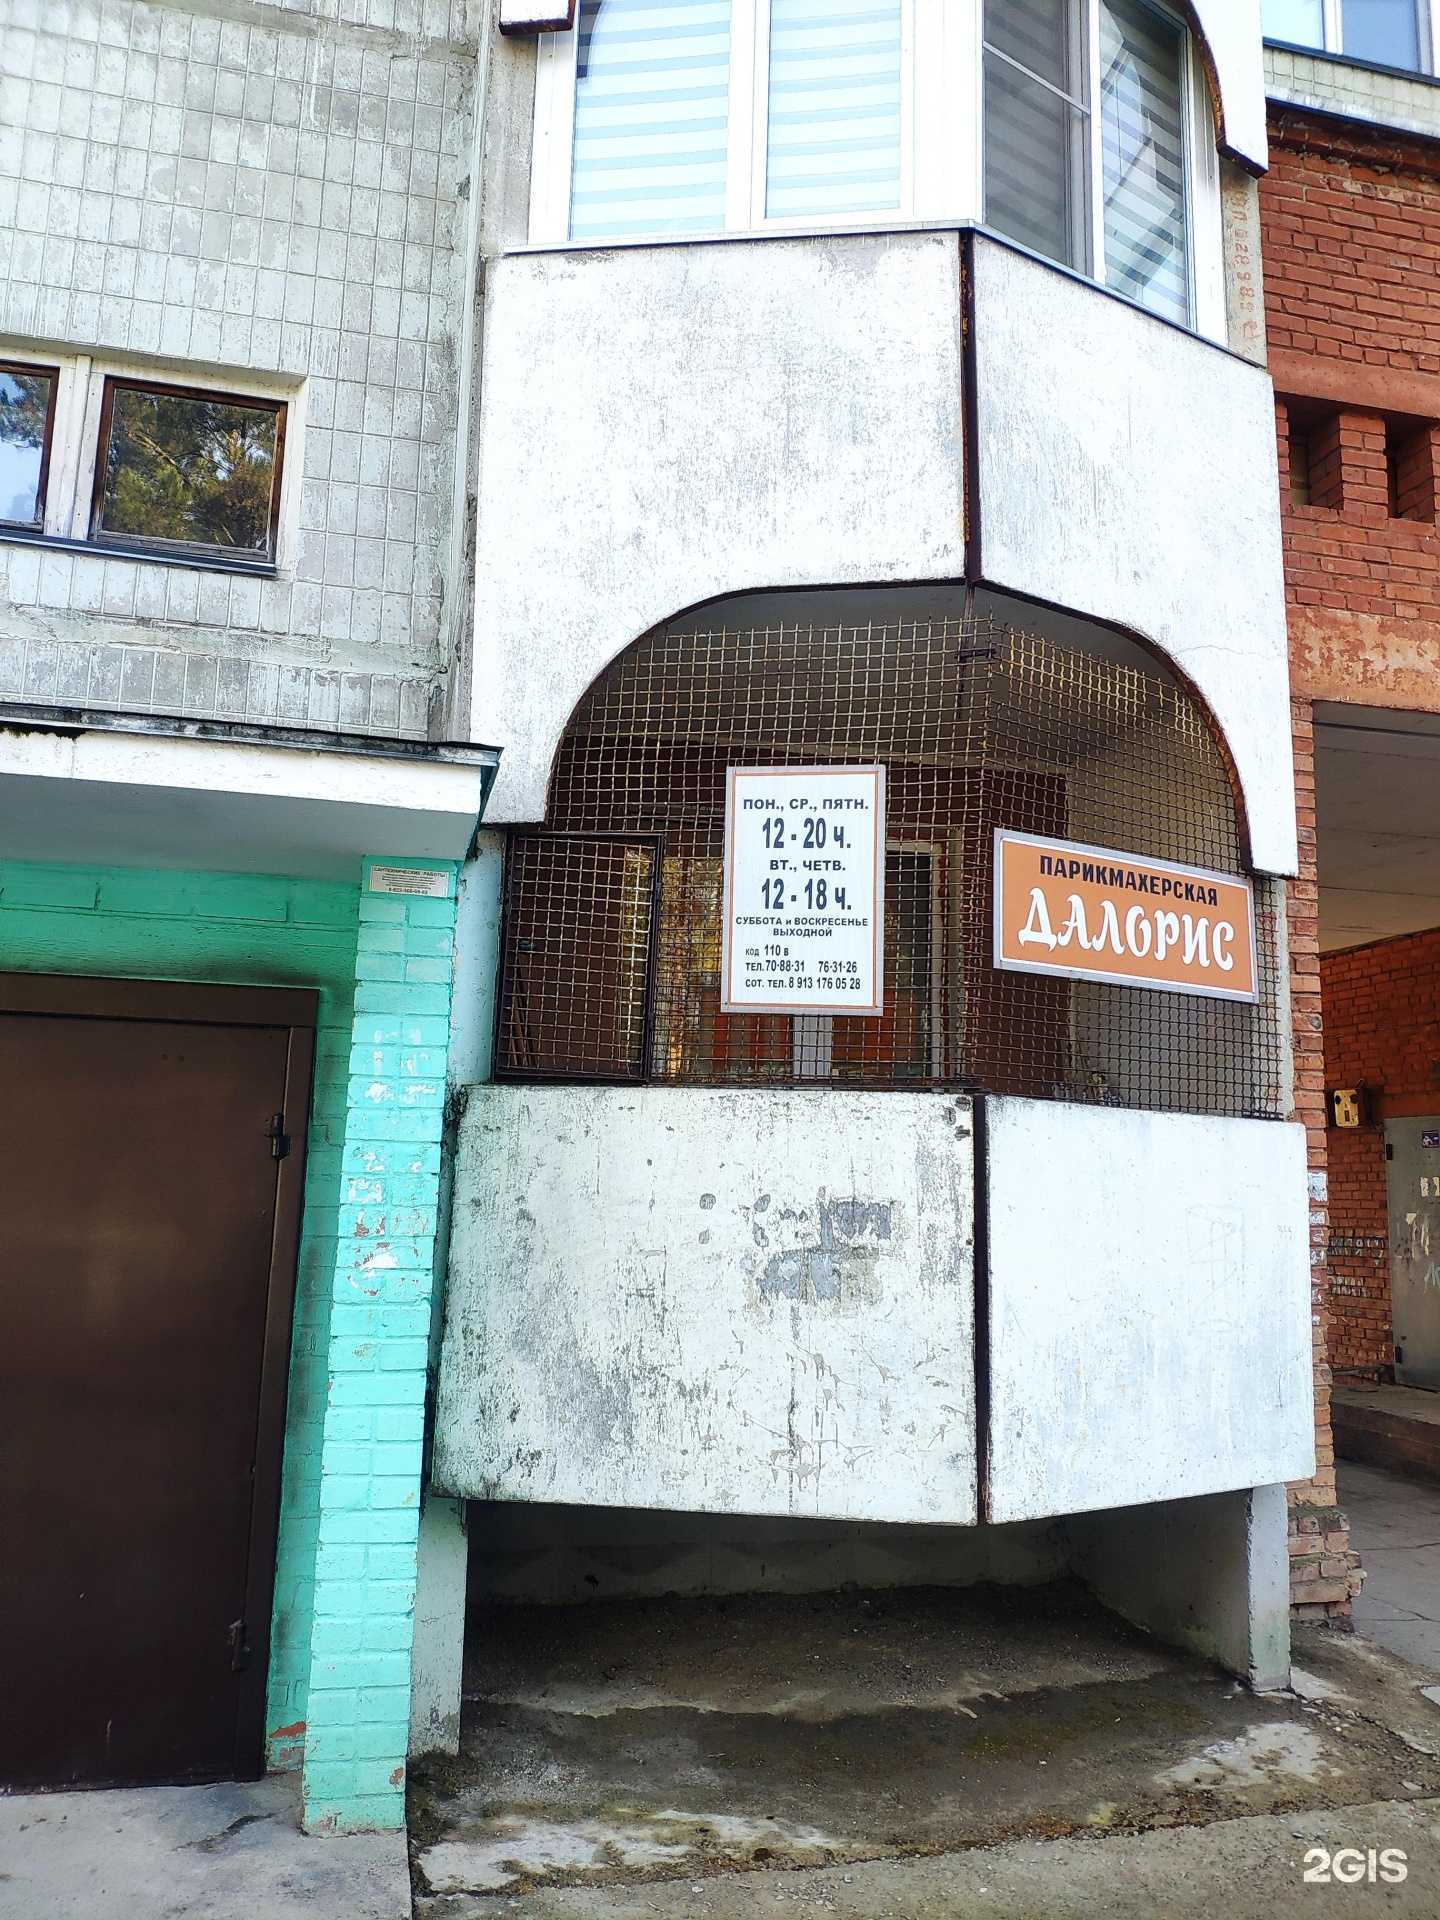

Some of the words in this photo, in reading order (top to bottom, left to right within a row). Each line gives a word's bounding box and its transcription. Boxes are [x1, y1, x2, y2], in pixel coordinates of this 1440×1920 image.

[743, 798, 784, 812] ПОН.,
[789, 798, 817, 812] СР.,
[822, 798, 869, 810] ПЯТН.
[762, 817, 785, 849] 12
[802, 817, 827, 849] 20
[769, 859, 797, 873] ВТ.,
[802, 859, 846, 871] ЧЕТВ.
[1040, 855, 1218, 906] ПАРИКМАХЕРСКАЯ
[761, 878, 785, 910] 12
[804, 878, 828, 911] 18
[735, 916, 783, 926] СУББОТА
[794, 917, 869, 927] ВОСКРЕСЕНЬЕ
[773, 927, 833, 939] ВЫХОДНОЙ
[1018, 887, 1234, 971] ДАЛОРИС
[764, 944, 781, 957] 110
[788, 976, 795, 989] 8
[797, 976, 813, 989] 913
[816, 976, 833, 990] 176
[835, 977, 847, 990] 05
[849, 977, 861, 990] 28
